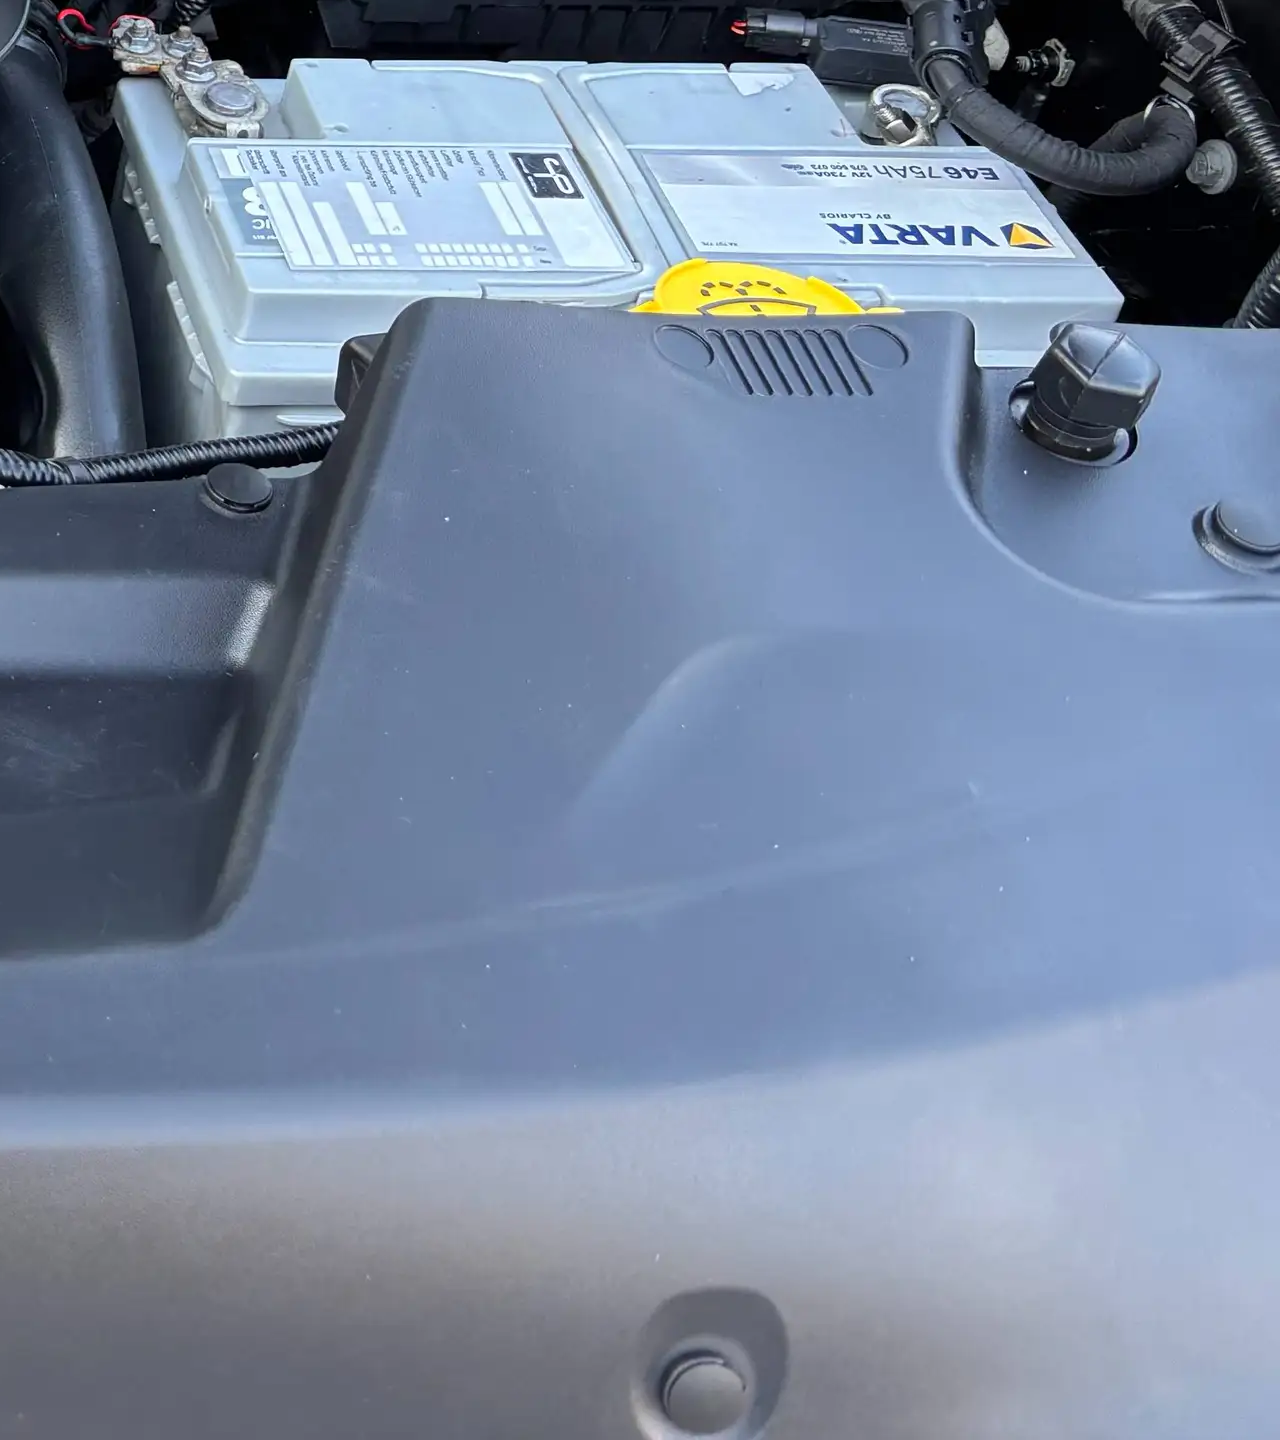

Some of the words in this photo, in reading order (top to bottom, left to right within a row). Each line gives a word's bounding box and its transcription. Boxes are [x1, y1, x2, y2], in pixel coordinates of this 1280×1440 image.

[872, 164, 940, 179] 75Ah
[942, 166, 1000, 181] E46
[826, 223, 1000, 247] VARTA
